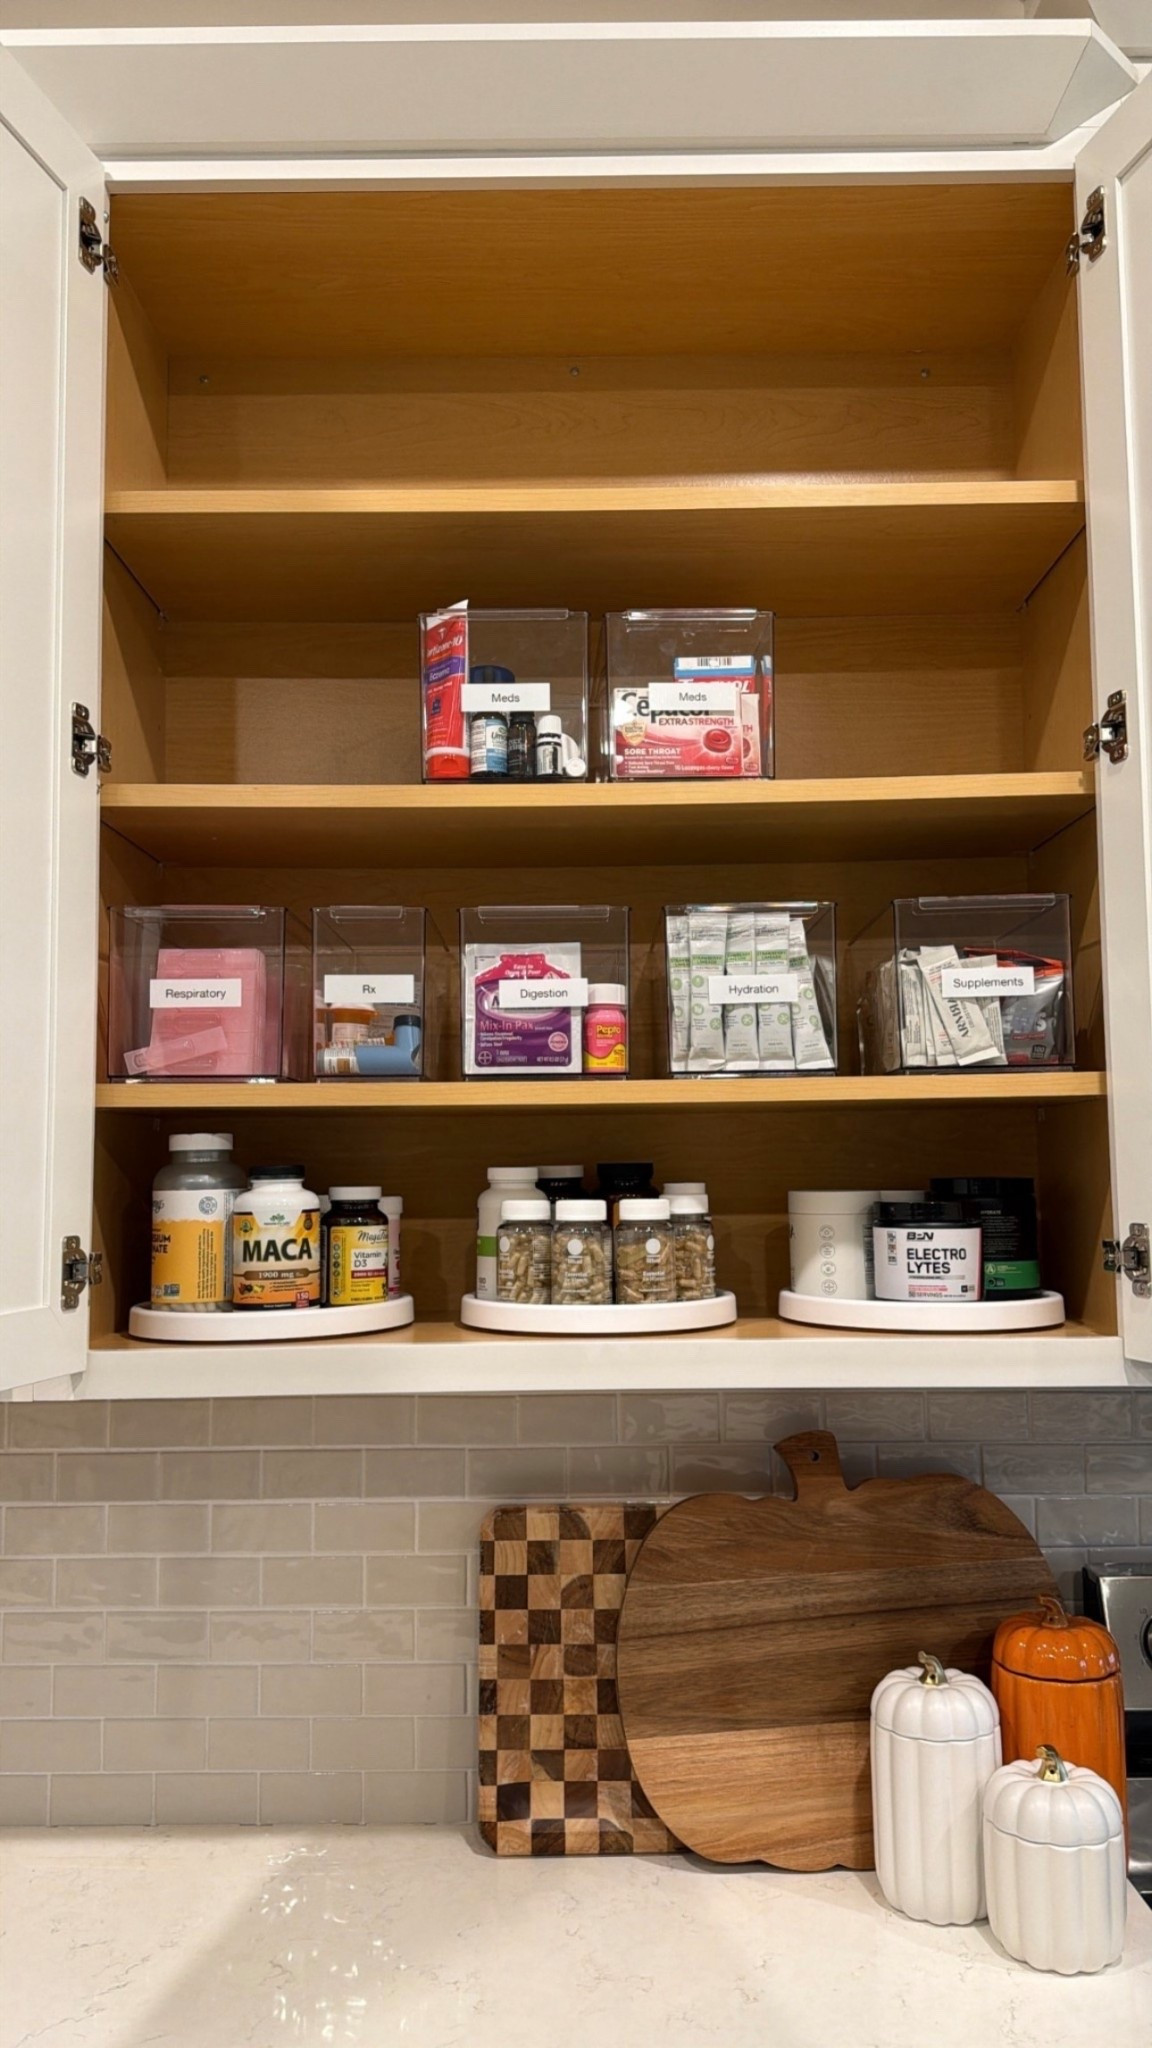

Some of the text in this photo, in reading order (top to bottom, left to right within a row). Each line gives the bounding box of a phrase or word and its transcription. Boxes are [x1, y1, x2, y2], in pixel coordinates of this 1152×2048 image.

[491, 693, 520, 703] Meds
[679, 692, 707, 702] Meds
[362, 984, 376, 994] Rx
[953, 977, 1024, 990] Supplements
[165, 989, 226, 1000] Respiratory
[520, 989, 568, 1001] Digestion
[729, 984, 779, 996] Hydration
[480, 1020, 512, 1031] Mix-In
[515, 1020, 534, 1030] Pax
[596, 1024, 621, 1035] Pepto
[152, 1234, 171, 1243] SIUM
[242, 1238, 313, 1262] MACA
[354, 1251, 382, 1259] Vitamin
[907, 1248, 967, 1260] ELECTRO
[354, 1260, 367, 1268] D3
[907, 1261, 951, 1274] LYTES
[258, 1271, 278, 1279] 1900
